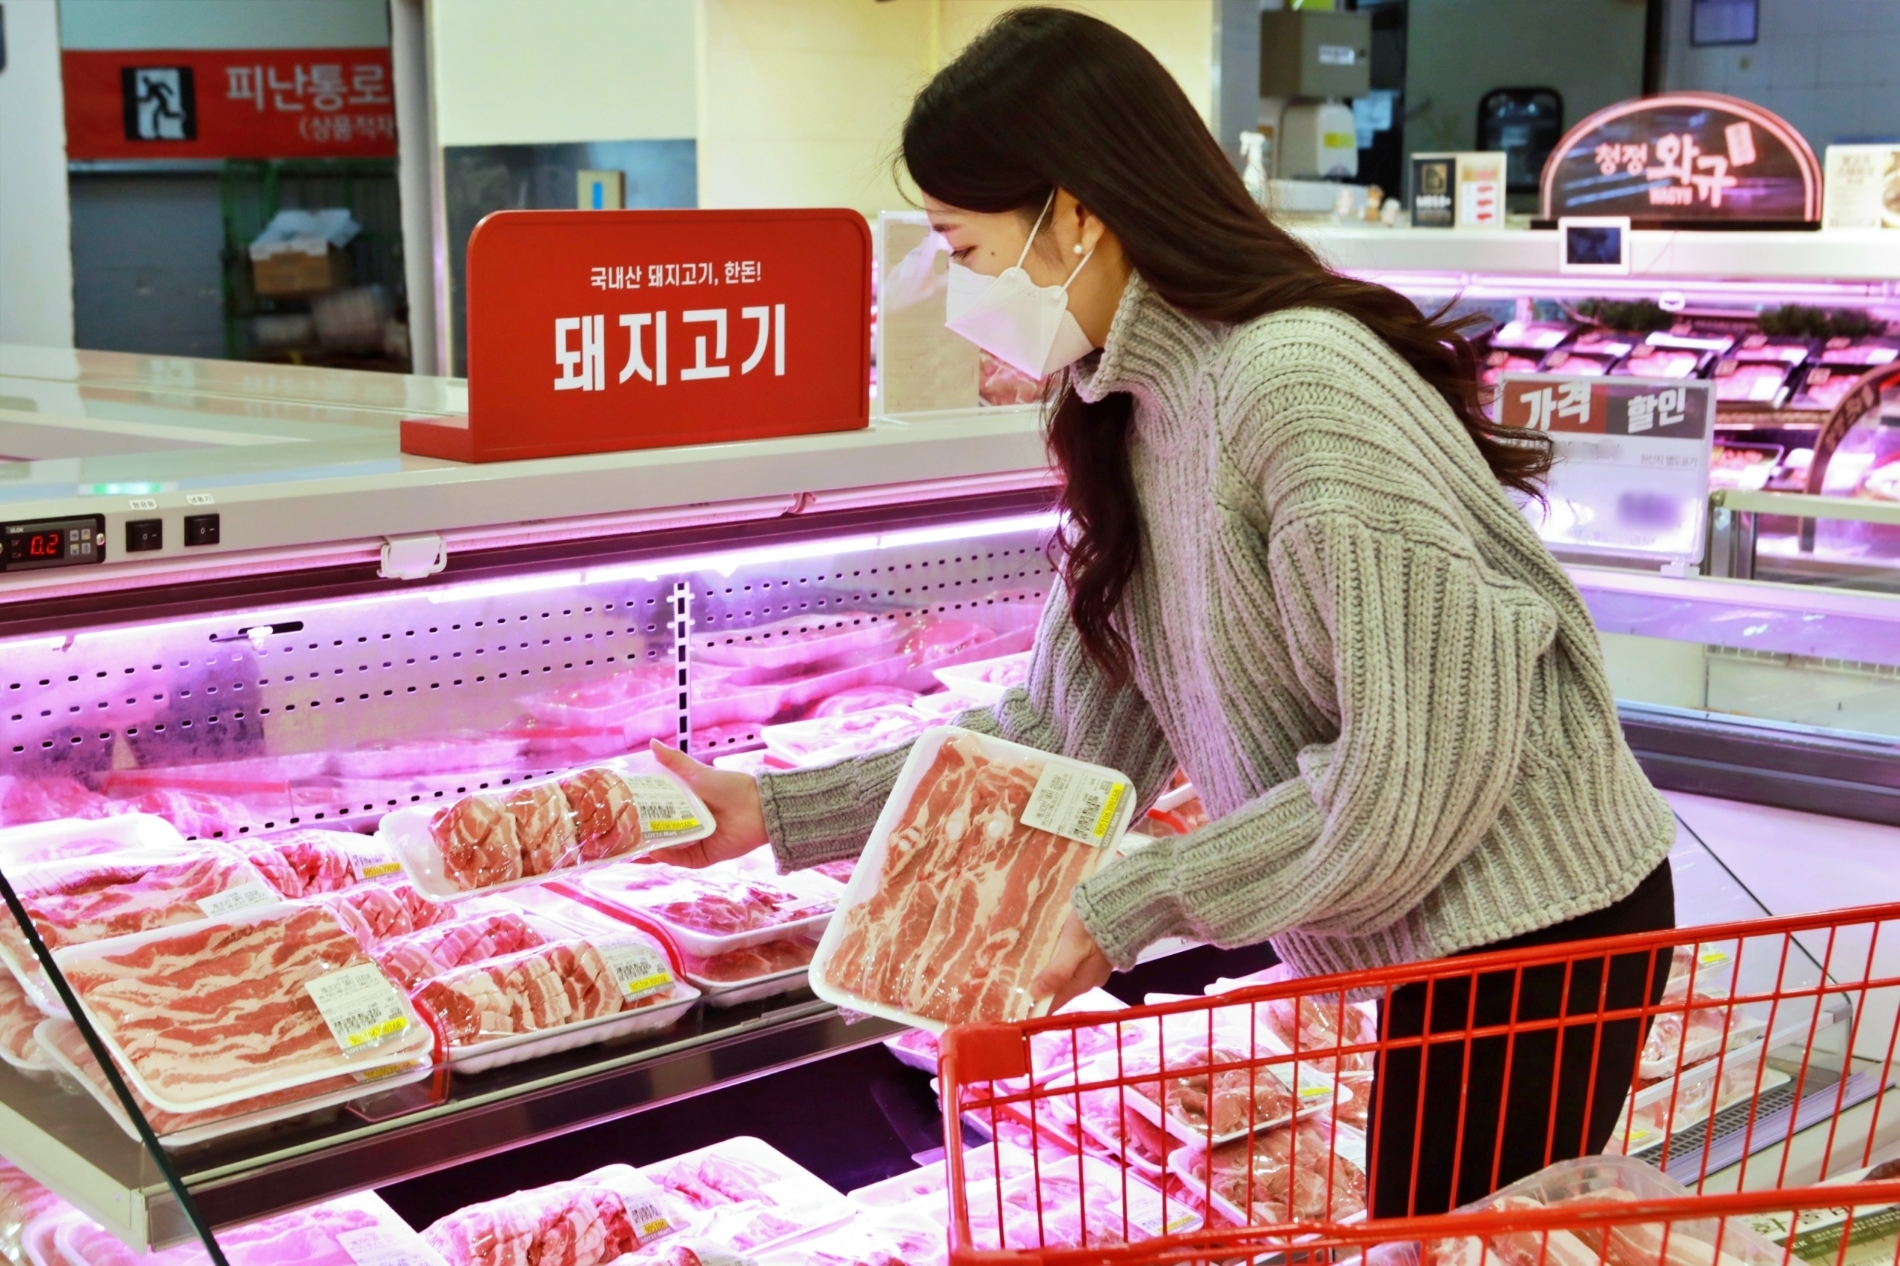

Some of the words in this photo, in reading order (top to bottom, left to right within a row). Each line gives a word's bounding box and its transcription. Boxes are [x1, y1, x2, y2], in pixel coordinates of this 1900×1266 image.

[226, 64, 390, 112] 피난통로
[1594, 141, 1648, 176] 청정
[1645, 132, 1738, 209] 와규
[590, 266, 642, 291] 국내산
[647, 261, 720, 289] 돼지고기,
[724, 259, 762, 285] 한돈!
[553, 303, 787, 392] 돼지고기
[1519, 381, 1592, 432] 가격
[1627, 387, 1686, 434] 할인
[30, 533, 59, 556] 0.2
[1095, 788, 1121, 835] 905106300168
